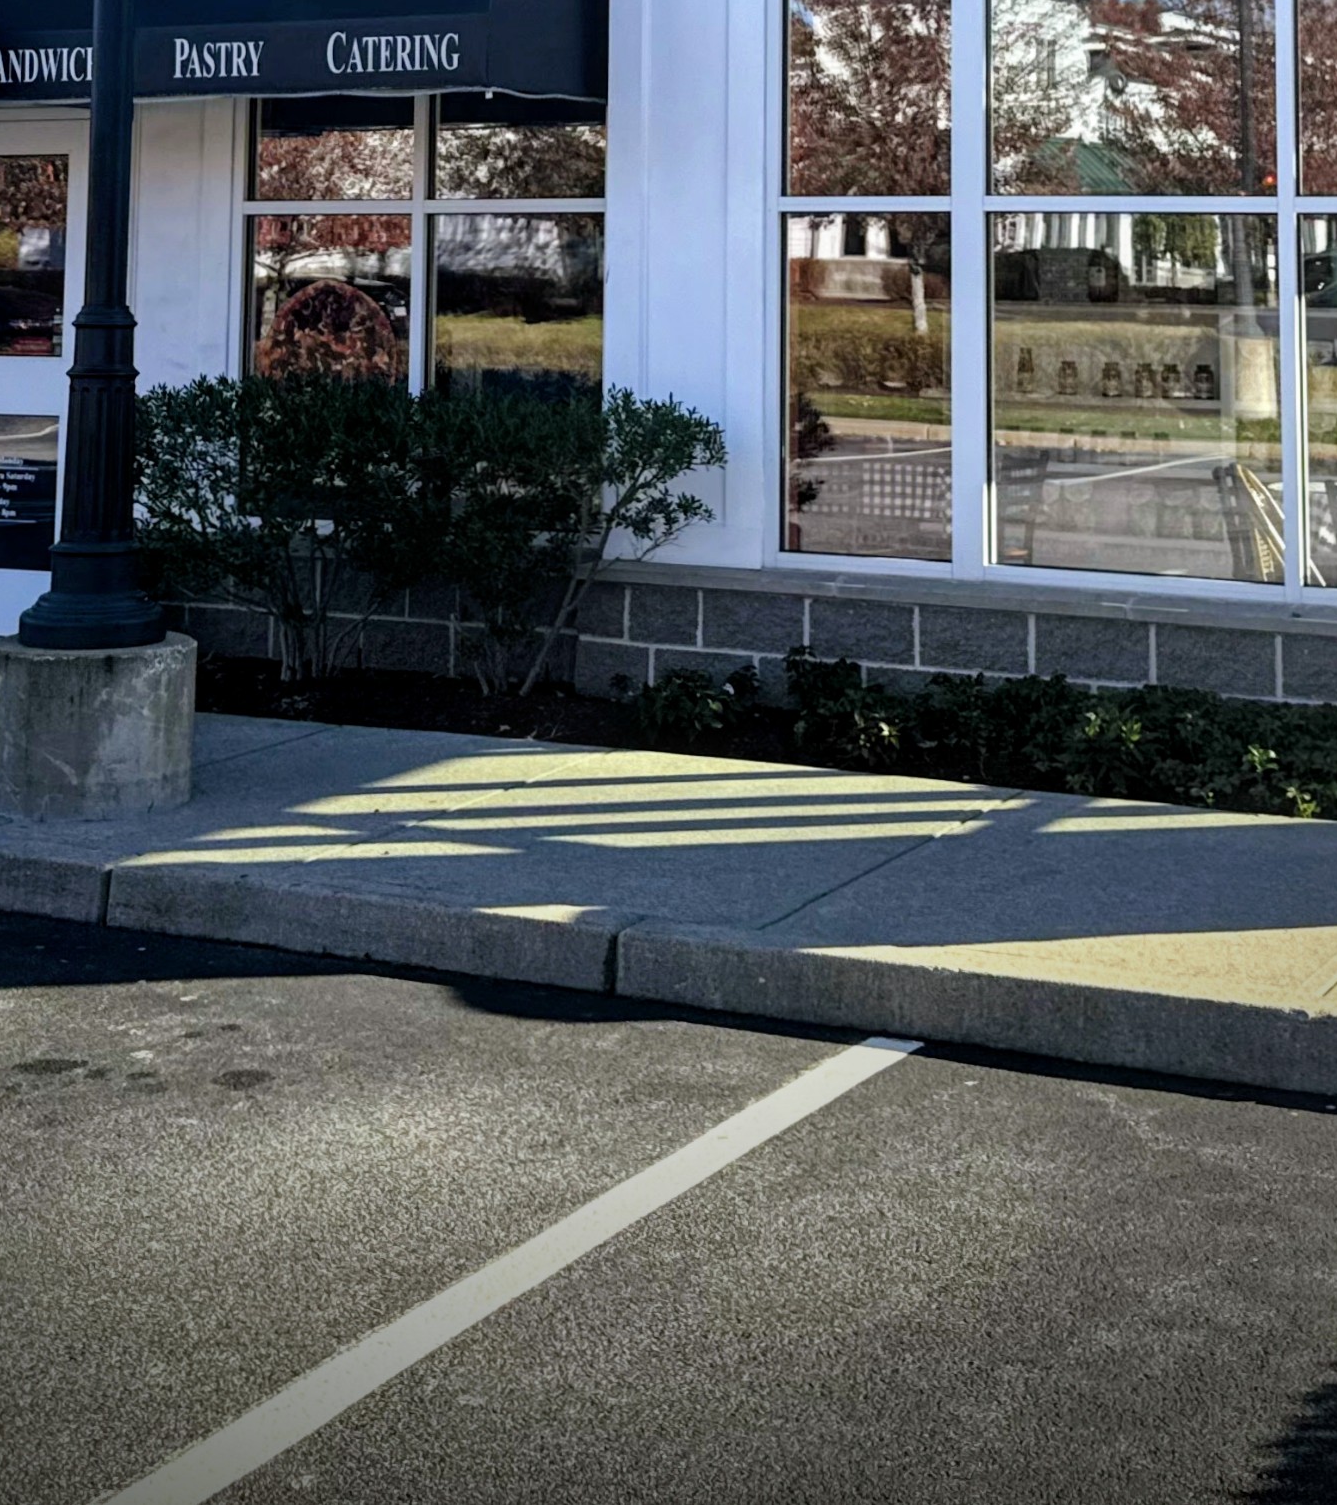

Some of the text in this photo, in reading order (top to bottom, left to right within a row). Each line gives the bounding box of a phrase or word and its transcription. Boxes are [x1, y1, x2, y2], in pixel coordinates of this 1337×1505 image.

[173, 37, 265, 79] PASTRY
[326, 31, 461, 74] CATERING
[6, 471, 35, 482] Saturday
